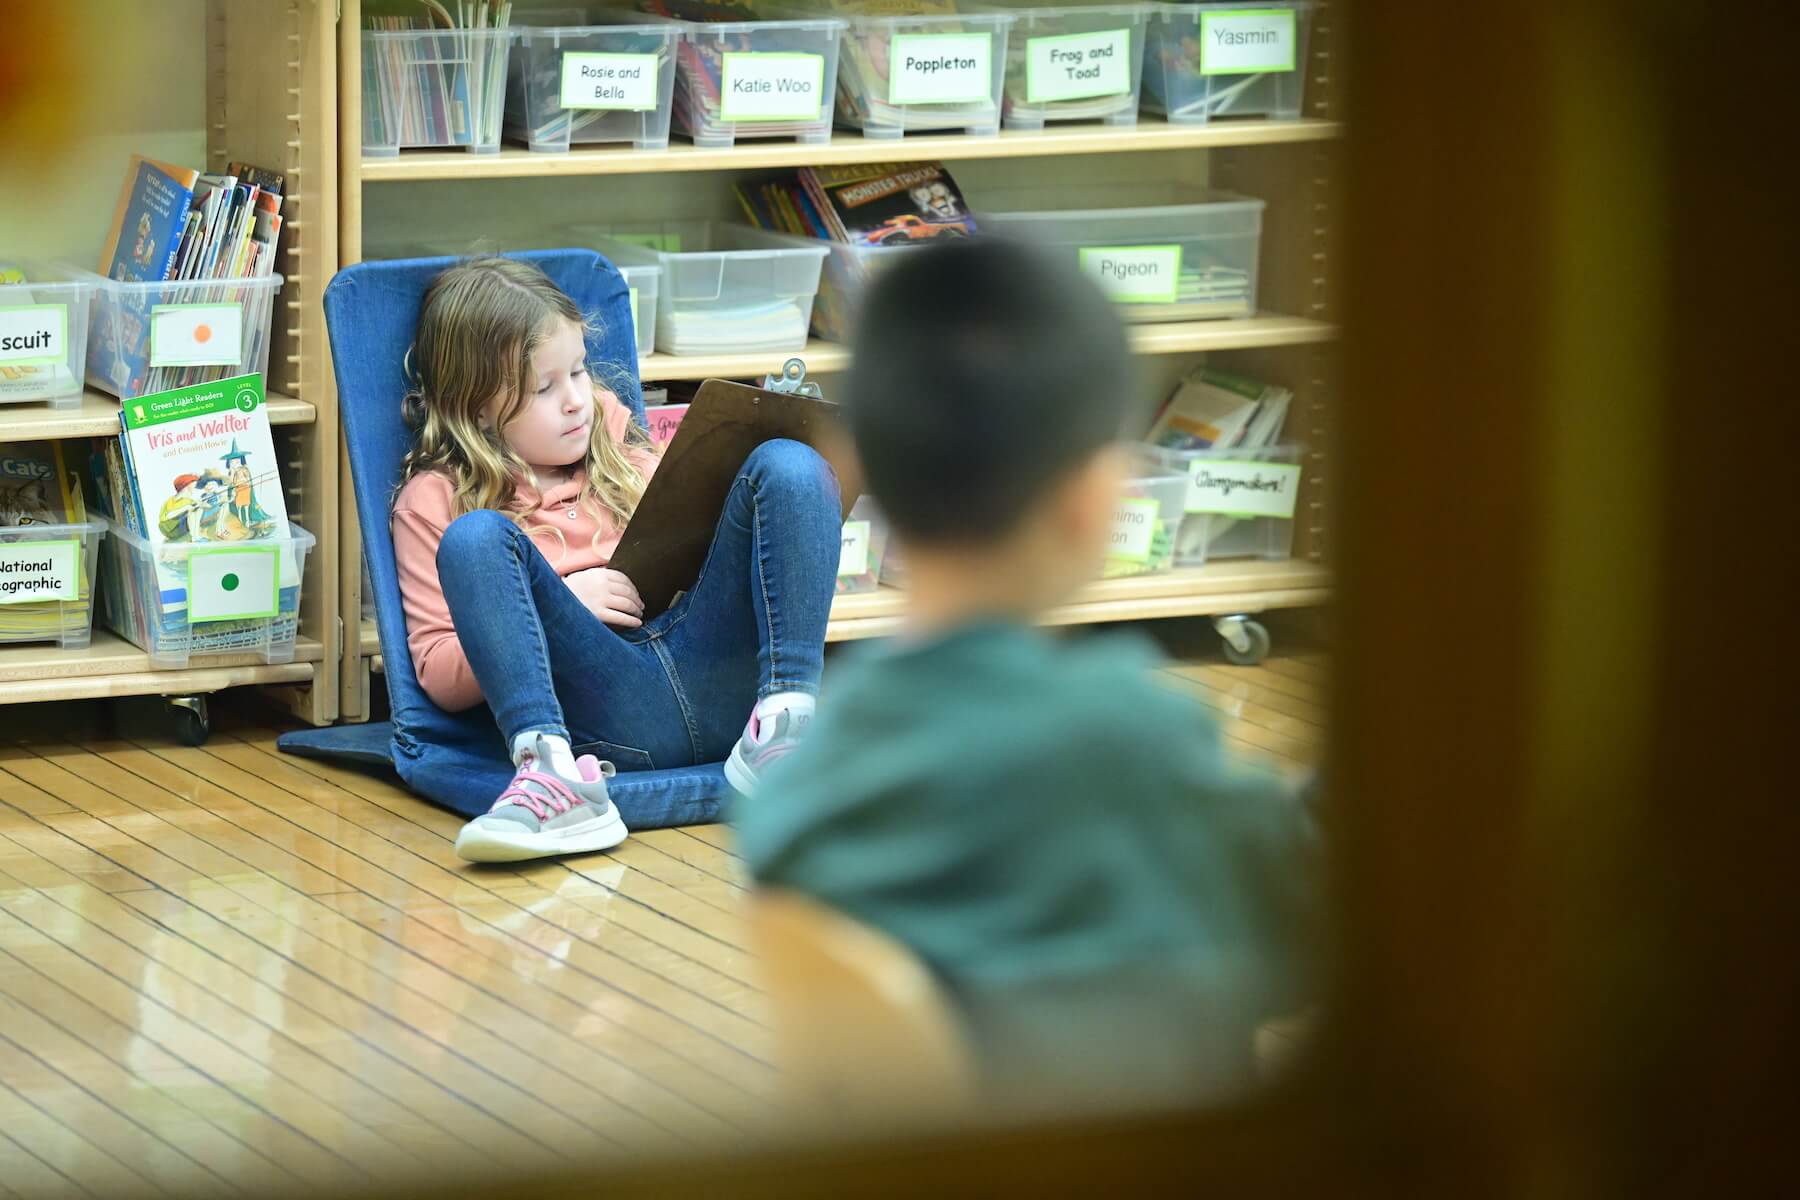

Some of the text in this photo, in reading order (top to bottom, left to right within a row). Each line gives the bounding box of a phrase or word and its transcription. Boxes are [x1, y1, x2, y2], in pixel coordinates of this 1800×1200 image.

[1214, 29, 1278, 46] Yasmin
[1050, 44, 1114, 65] Frog and
[581, 65, 641, 79] Rosie and
[906, 56, 976, 73] Poppleton
[1066, 64, 1100, 80] Toad
[594, 85, 625, 99] Bella
[733, 78, 811, 93] Katie Woo
[842, 176, 897, 204] MONSTER
[1100, 258, 1159, 280] Pigeon
[1, 330, 52, 351] scuit
[151, 391, 253, 412] Green Light Readers 3
[147, 414, 251, 450] Iris and Walter
[2, 459, 52, 478] Cats
